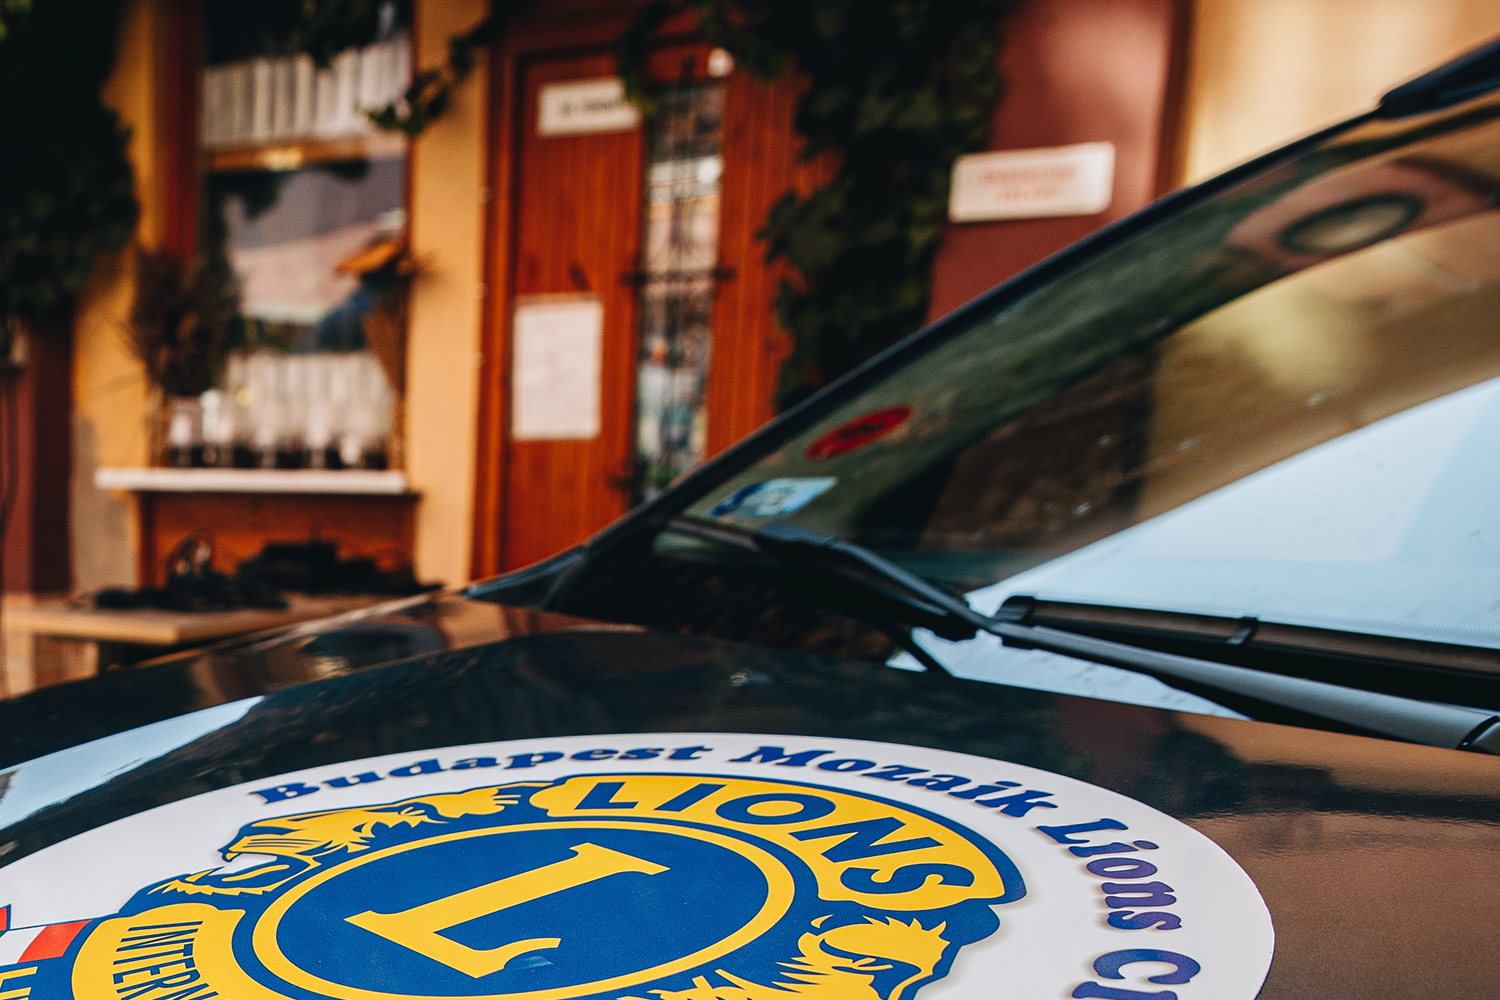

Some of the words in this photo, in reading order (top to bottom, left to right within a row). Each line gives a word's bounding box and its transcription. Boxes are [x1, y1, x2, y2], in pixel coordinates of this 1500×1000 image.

[248, 743, 714, 805] Budapest
[726, 745, 1058, 818] Mozaik
[1037, 817, 1182, 931] Lions
[574, 782, 974, 895] LIONS
[344, 842, 671, 979] L
